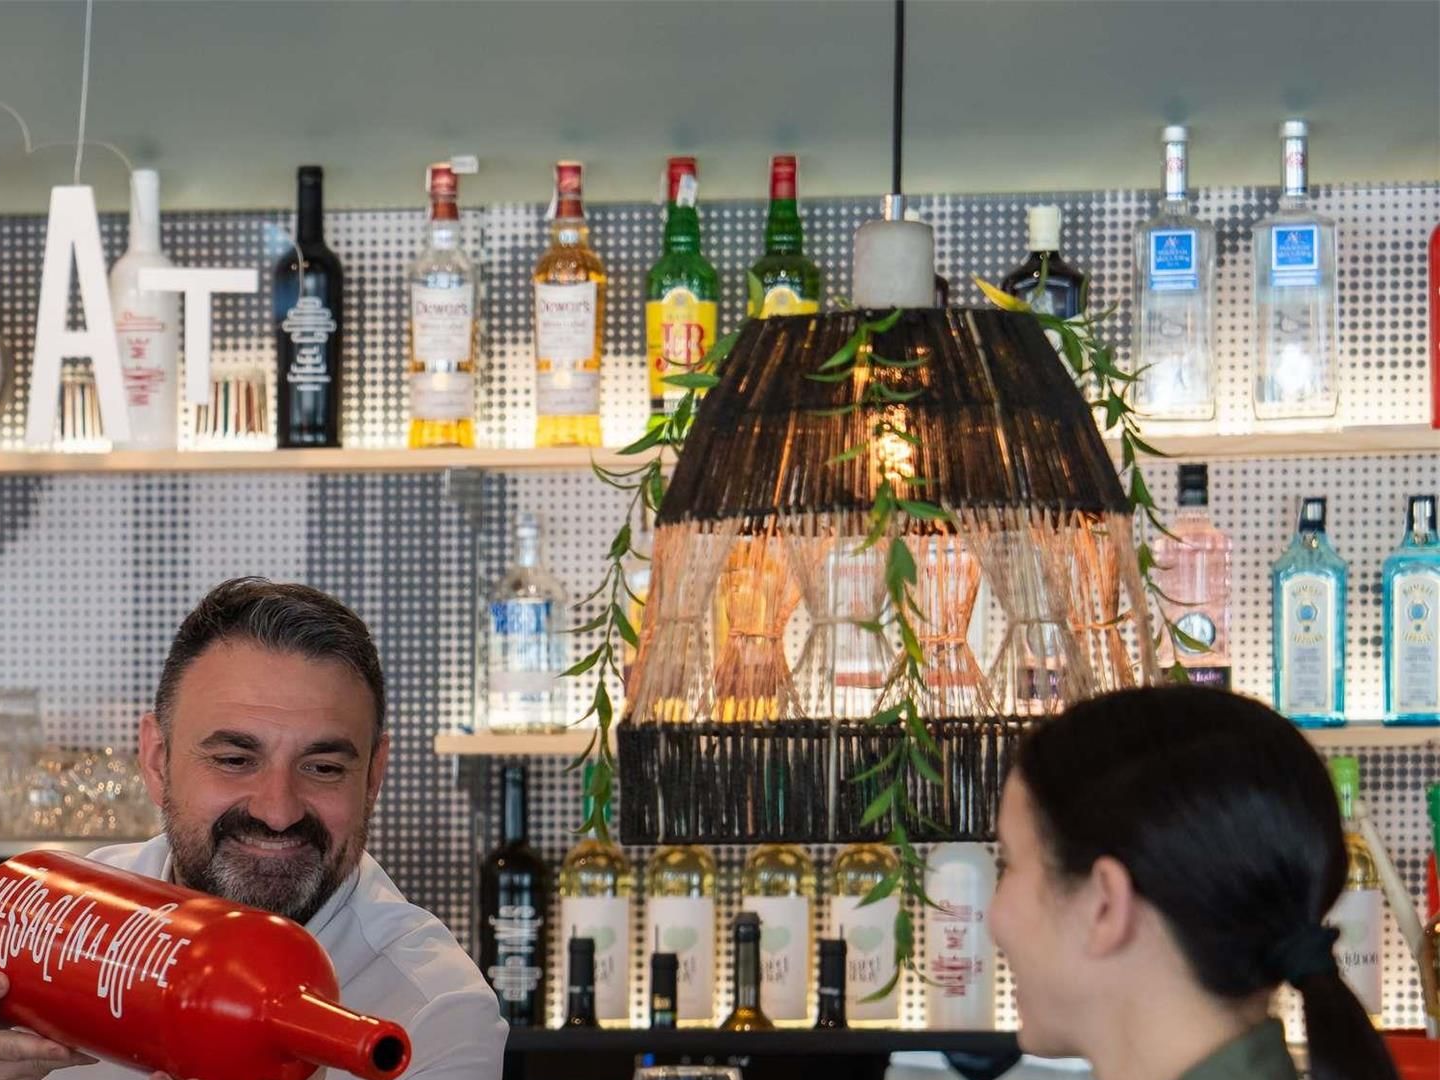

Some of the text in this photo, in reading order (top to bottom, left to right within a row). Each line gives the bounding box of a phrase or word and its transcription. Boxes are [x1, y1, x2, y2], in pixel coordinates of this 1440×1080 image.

[286, 346, 332, 382] FEEL
[85, 923, 109, 961] A
[97, 903, 192, 1018] BOTTLE
